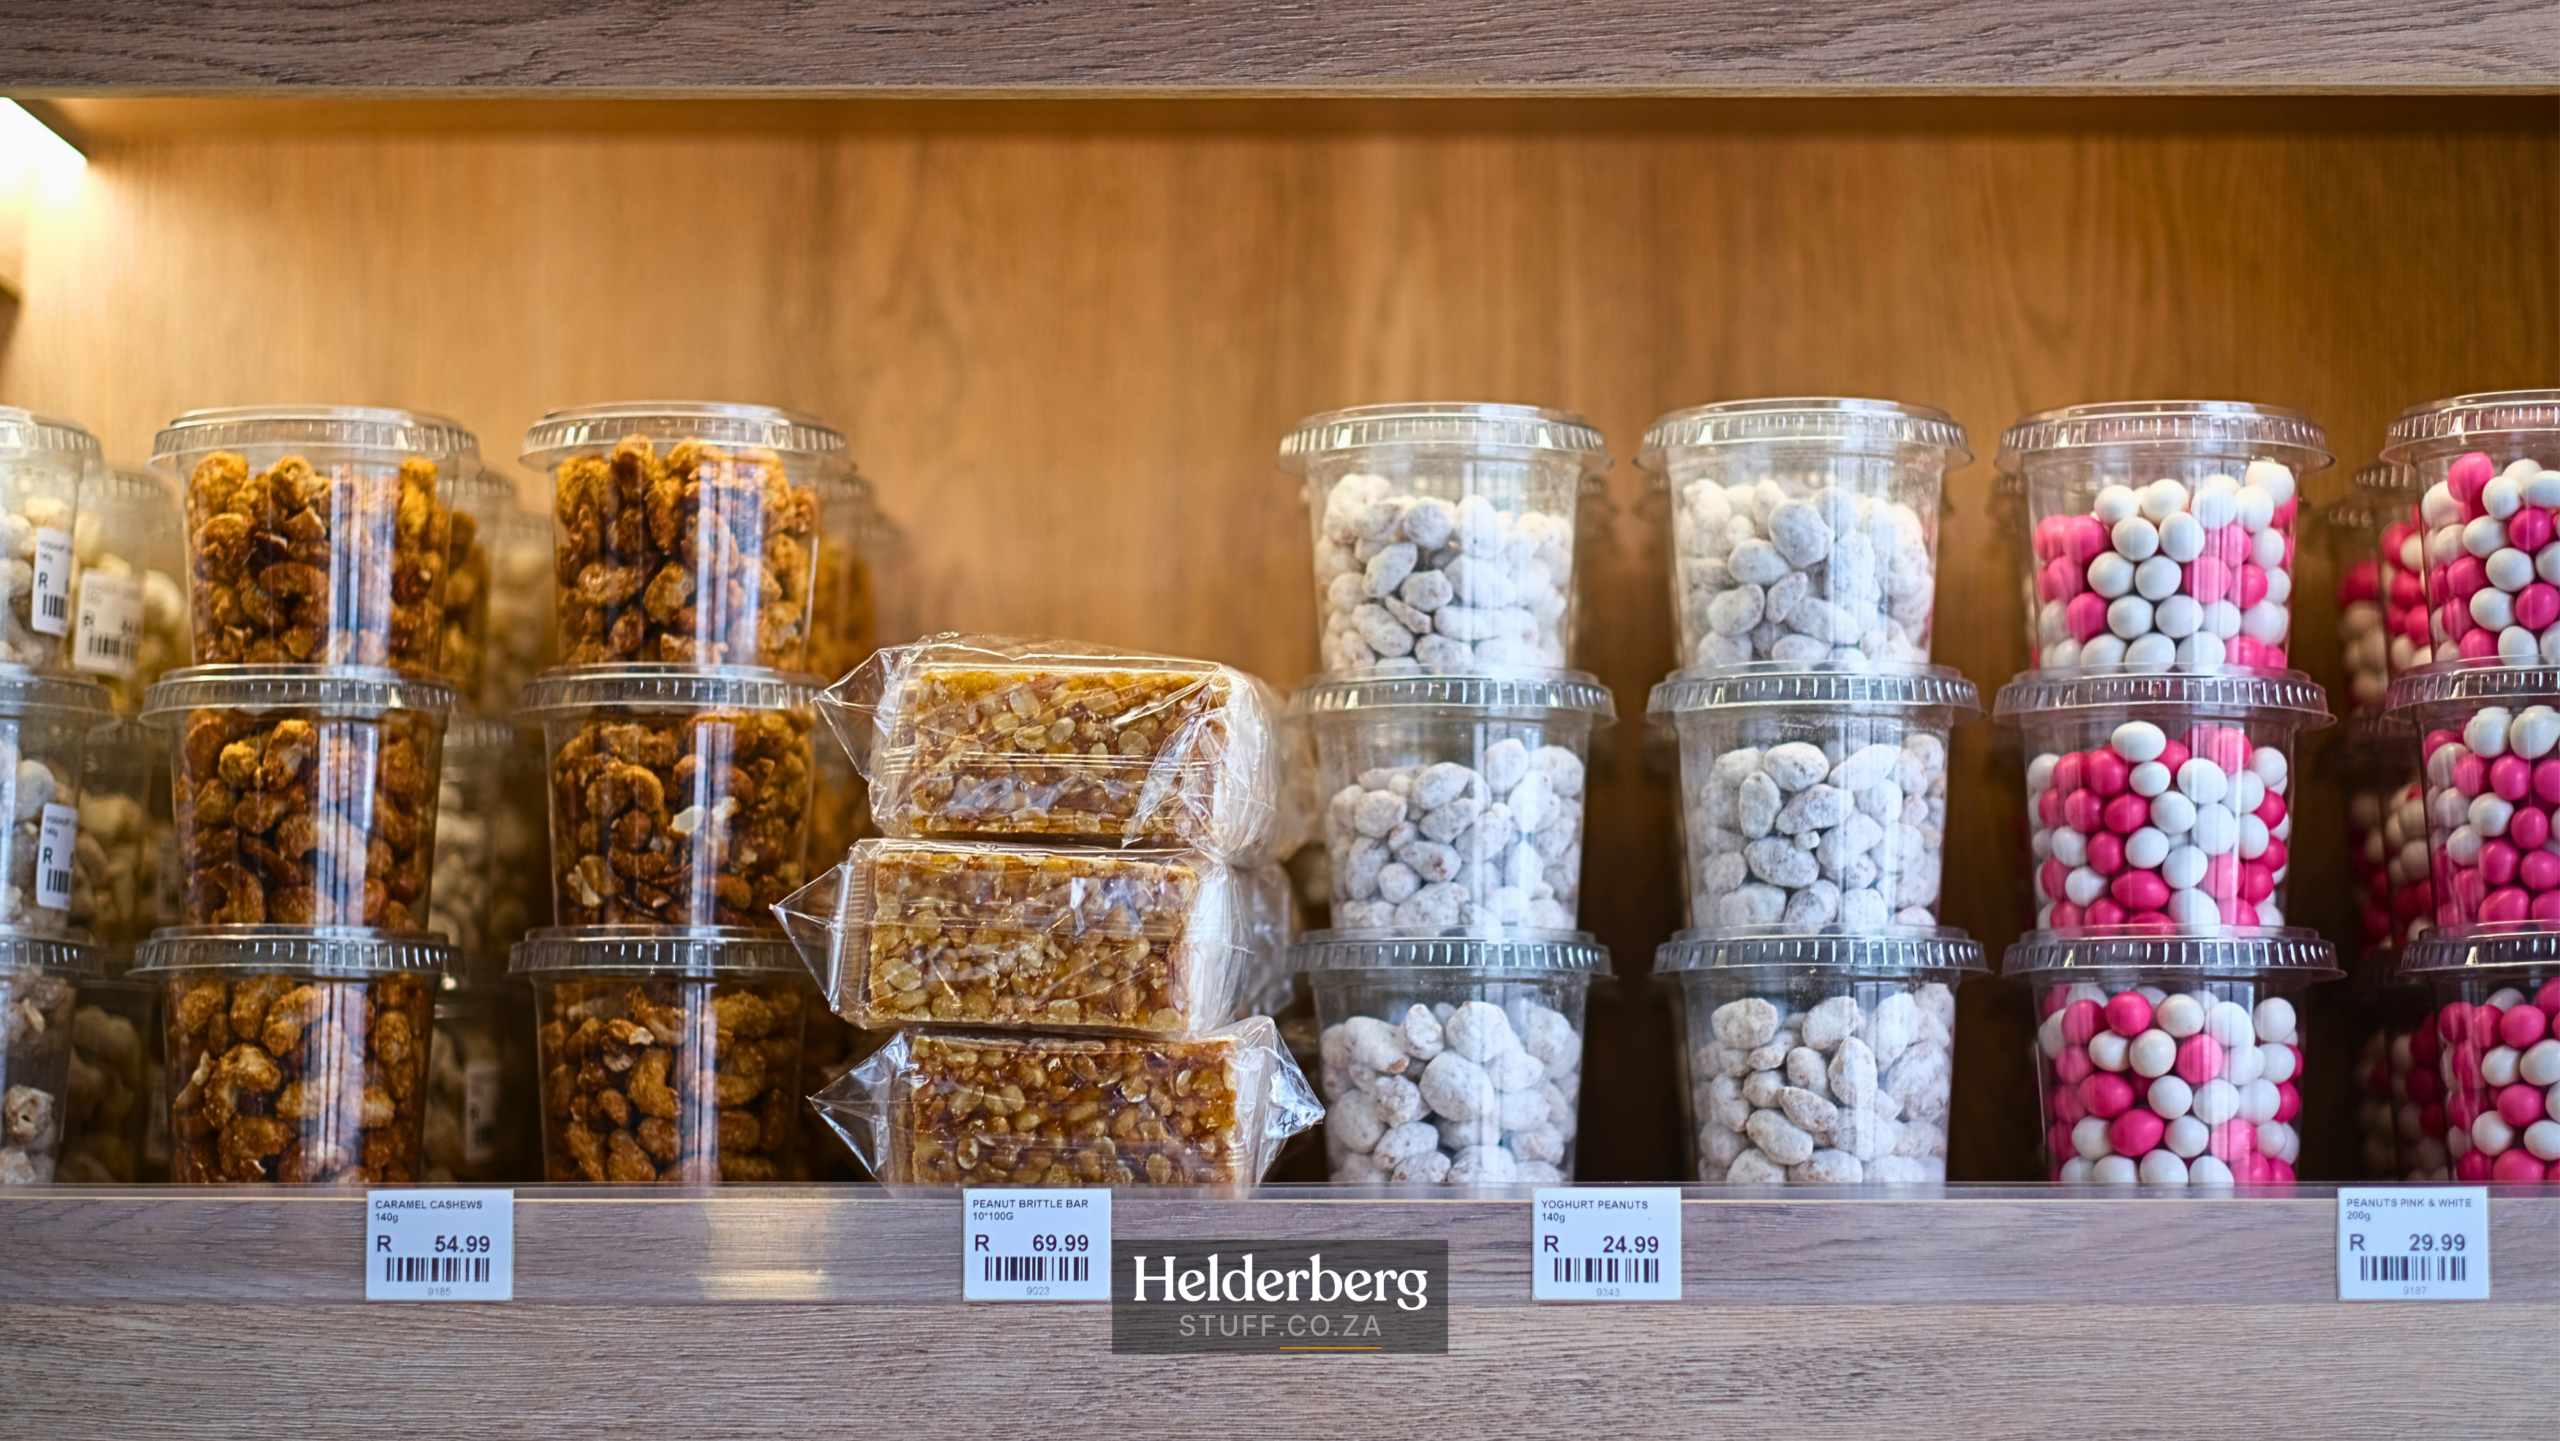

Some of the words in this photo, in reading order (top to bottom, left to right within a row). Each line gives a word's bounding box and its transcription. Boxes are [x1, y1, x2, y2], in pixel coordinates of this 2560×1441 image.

[38, 572, 48, 589] R
[43, 847, 53, 864] R
[375, 1200, 427, 1209] CARAMEL
[430, 1200, 483, 1209] CASHEWS
[973, 1199, 1016, 1208] PEANUT
[1019, 1199, 1063, 1208] BRITTLE
[1066, 1199, 1088, 1208] BAR
[1541, 1200, 1594, 1209] YOGHURT
[1598, 1200, 1648, 1209] PEANUTS
[2346, 1198, 2397, 1207] PEANUTS
[2400, 1198, 2424, 1207] PINK
[2428, 1198, 2435, 1207] &
[2438, 1198, 2472, 1207] WHITE
[375, 1213, 398, 1223] 140g
[1542, 1212, 1565, 1223] 140g
[2346, 1211, 2370, 1222] 200g
[377, 1235, 392, 1252] R
[435, 1235, 490, 1253] 54.99
[975, 1234, 990, 1252] R
[1032, 1234, 1089, 1252] 69.99
[1544, 1235, 1559, 1253] R
[1602, 1235, 1659, 1253] 24.99
[2349, 1234, 2365, 1251] R
[2409, 1233, 2465, 1251] 29.99
[427, 1287, 451, 1296] 9185
[1026, 1286, 1050, 1296] 9023
[1596, 1288, 1620, 1297] 9343
[2403, 1286, 2427, 1296] 9187
